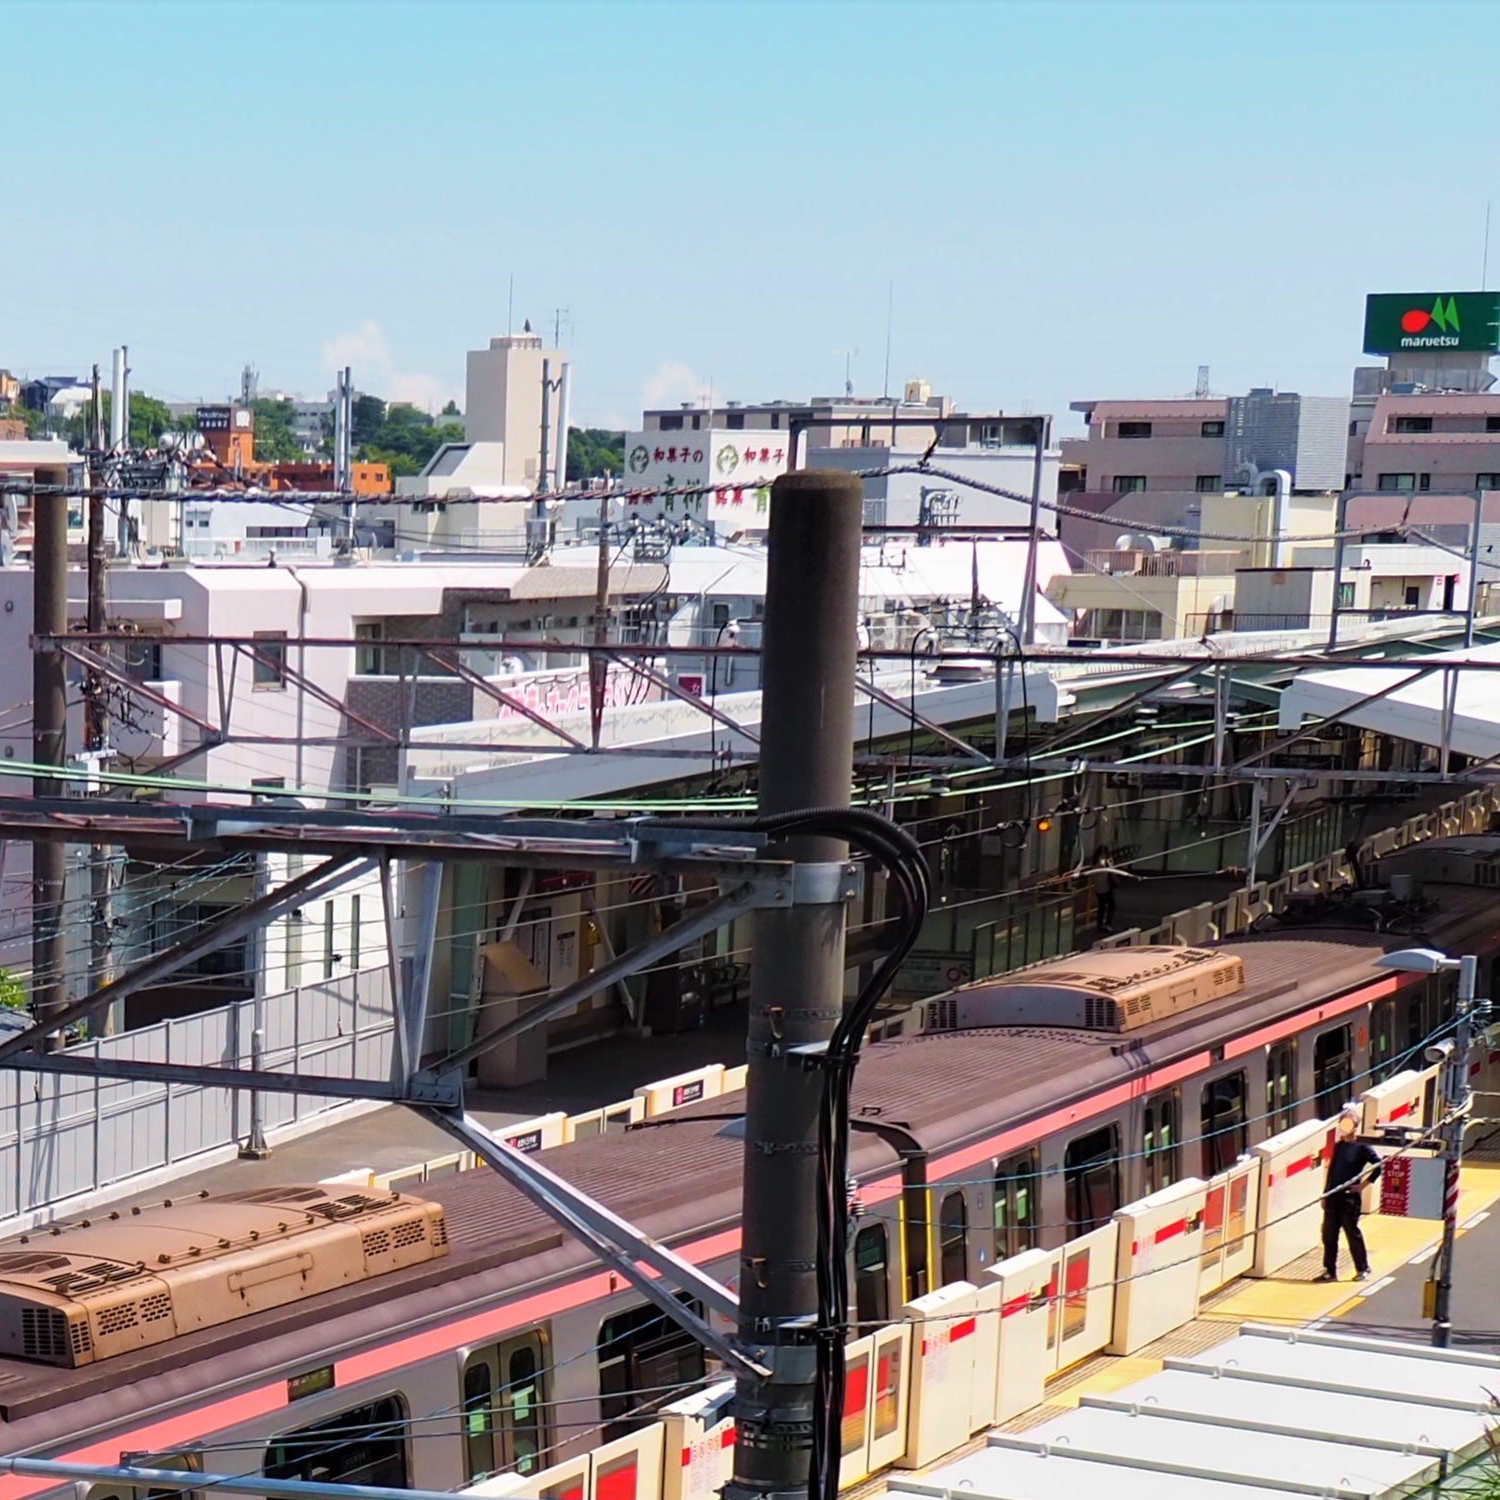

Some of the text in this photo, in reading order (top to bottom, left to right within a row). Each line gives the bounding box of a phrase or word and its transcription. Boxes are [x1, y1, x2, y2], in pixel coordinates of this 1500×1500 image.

[1401, 335, 1460, 347] maruetsu
[653, 446, 704, 464] 和菓子の
